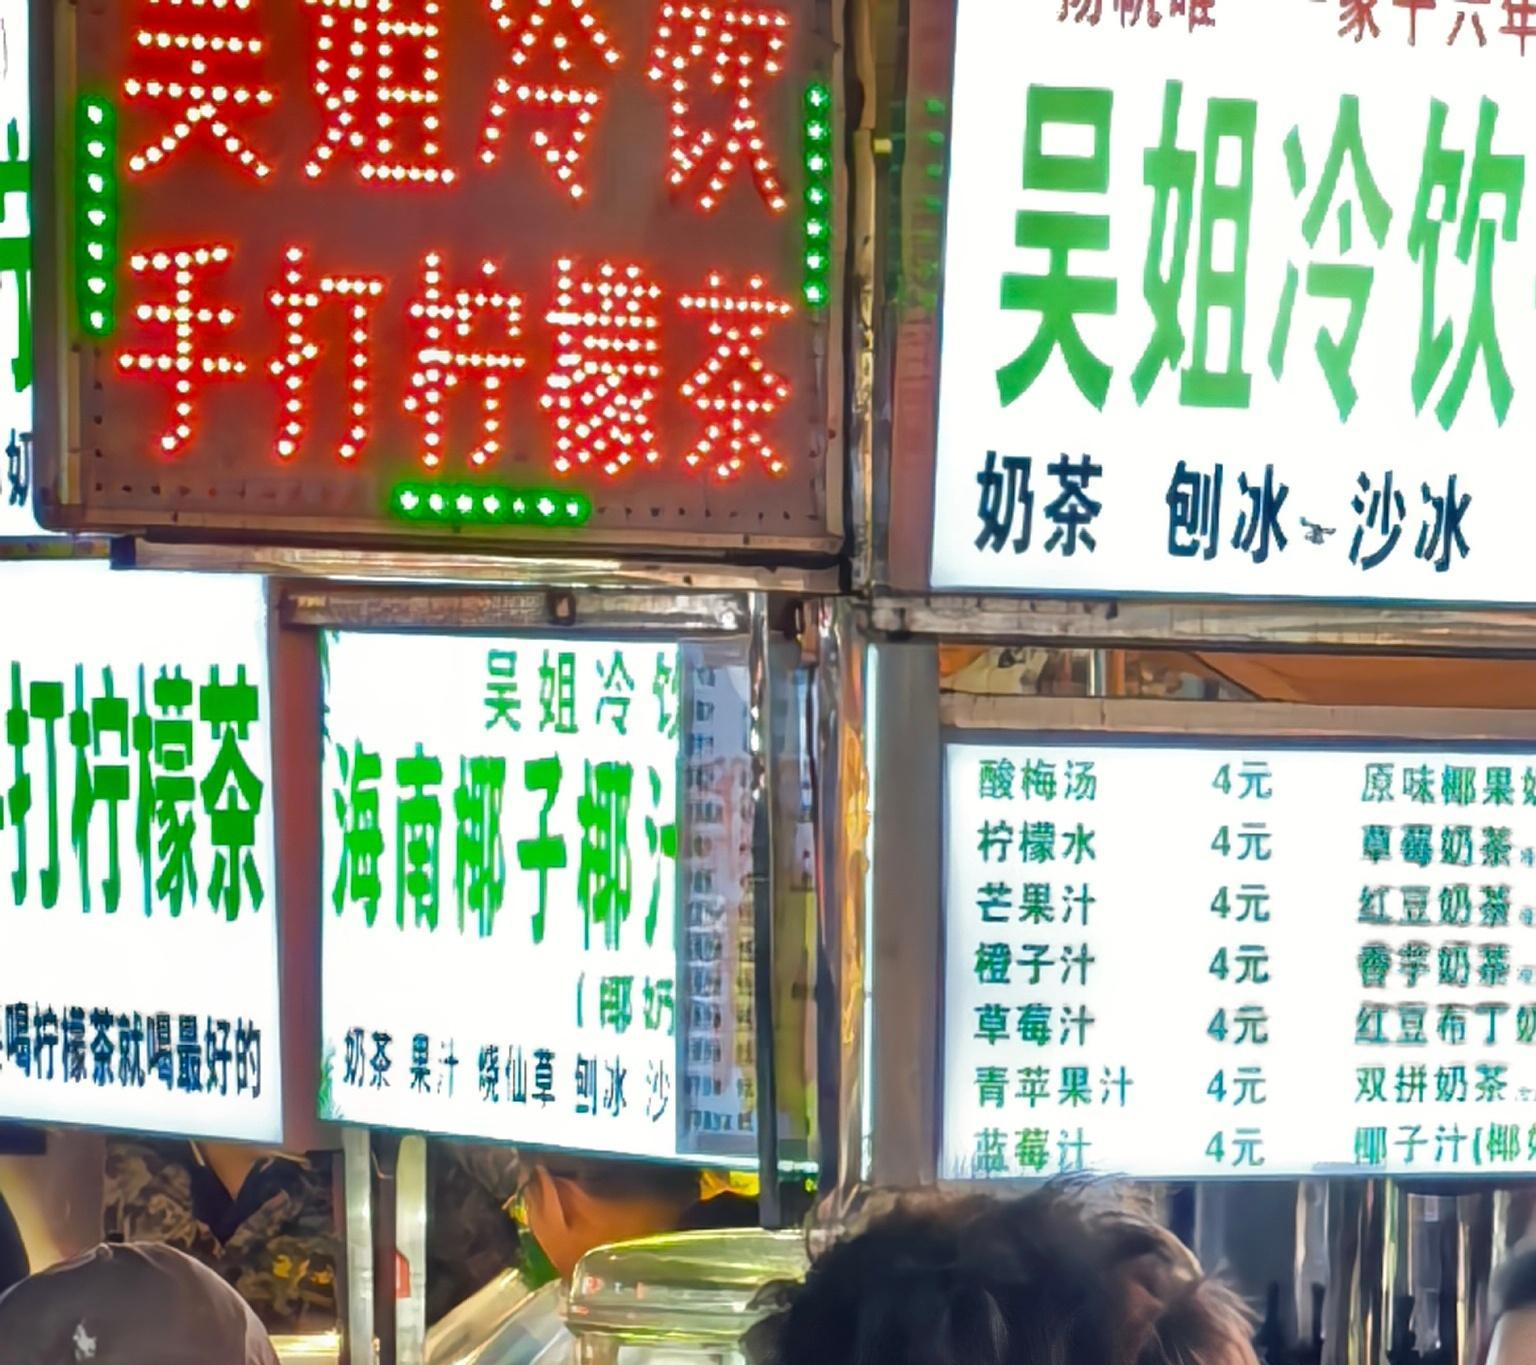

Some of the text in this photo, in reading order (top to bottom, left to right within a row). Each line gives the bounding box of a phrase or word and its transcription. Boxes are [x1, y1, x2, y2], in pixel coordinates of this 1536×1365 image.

[122, 0, 790, 212] 吴姐冷饮
[116, 243, 796, 478] 手打柠檬茶
[974, 450, 1102, 556] 奶茶
[0, 661, 264, 922] 打柠檬茶
[978, 757, 1272, 802] 酸梅汤 4元
[977, 819, 1272, 865] 柠檬水 4元
[975, 881, 1270, 926] 芒果汁 4元
[974, 941, 1271, 986] 橙子汁 4元
[972, 1002, 1269, 1048] 草莓汁 4元
[0, 1002, 261, 1098] 喝柠檬茶就喝最好的
[343, 1028, 392, 1089] 奶茶
[410, 1033, 459, 1094] 果汁
[478, 1045, 555, 1106] 烧仙草
[974, 1065, 1266, 1109] 青苹果汁 4元
[1355, 1063, 1508, 1104] 双拼奶茶
[1205, 1128, 1265, 1167] 4元
